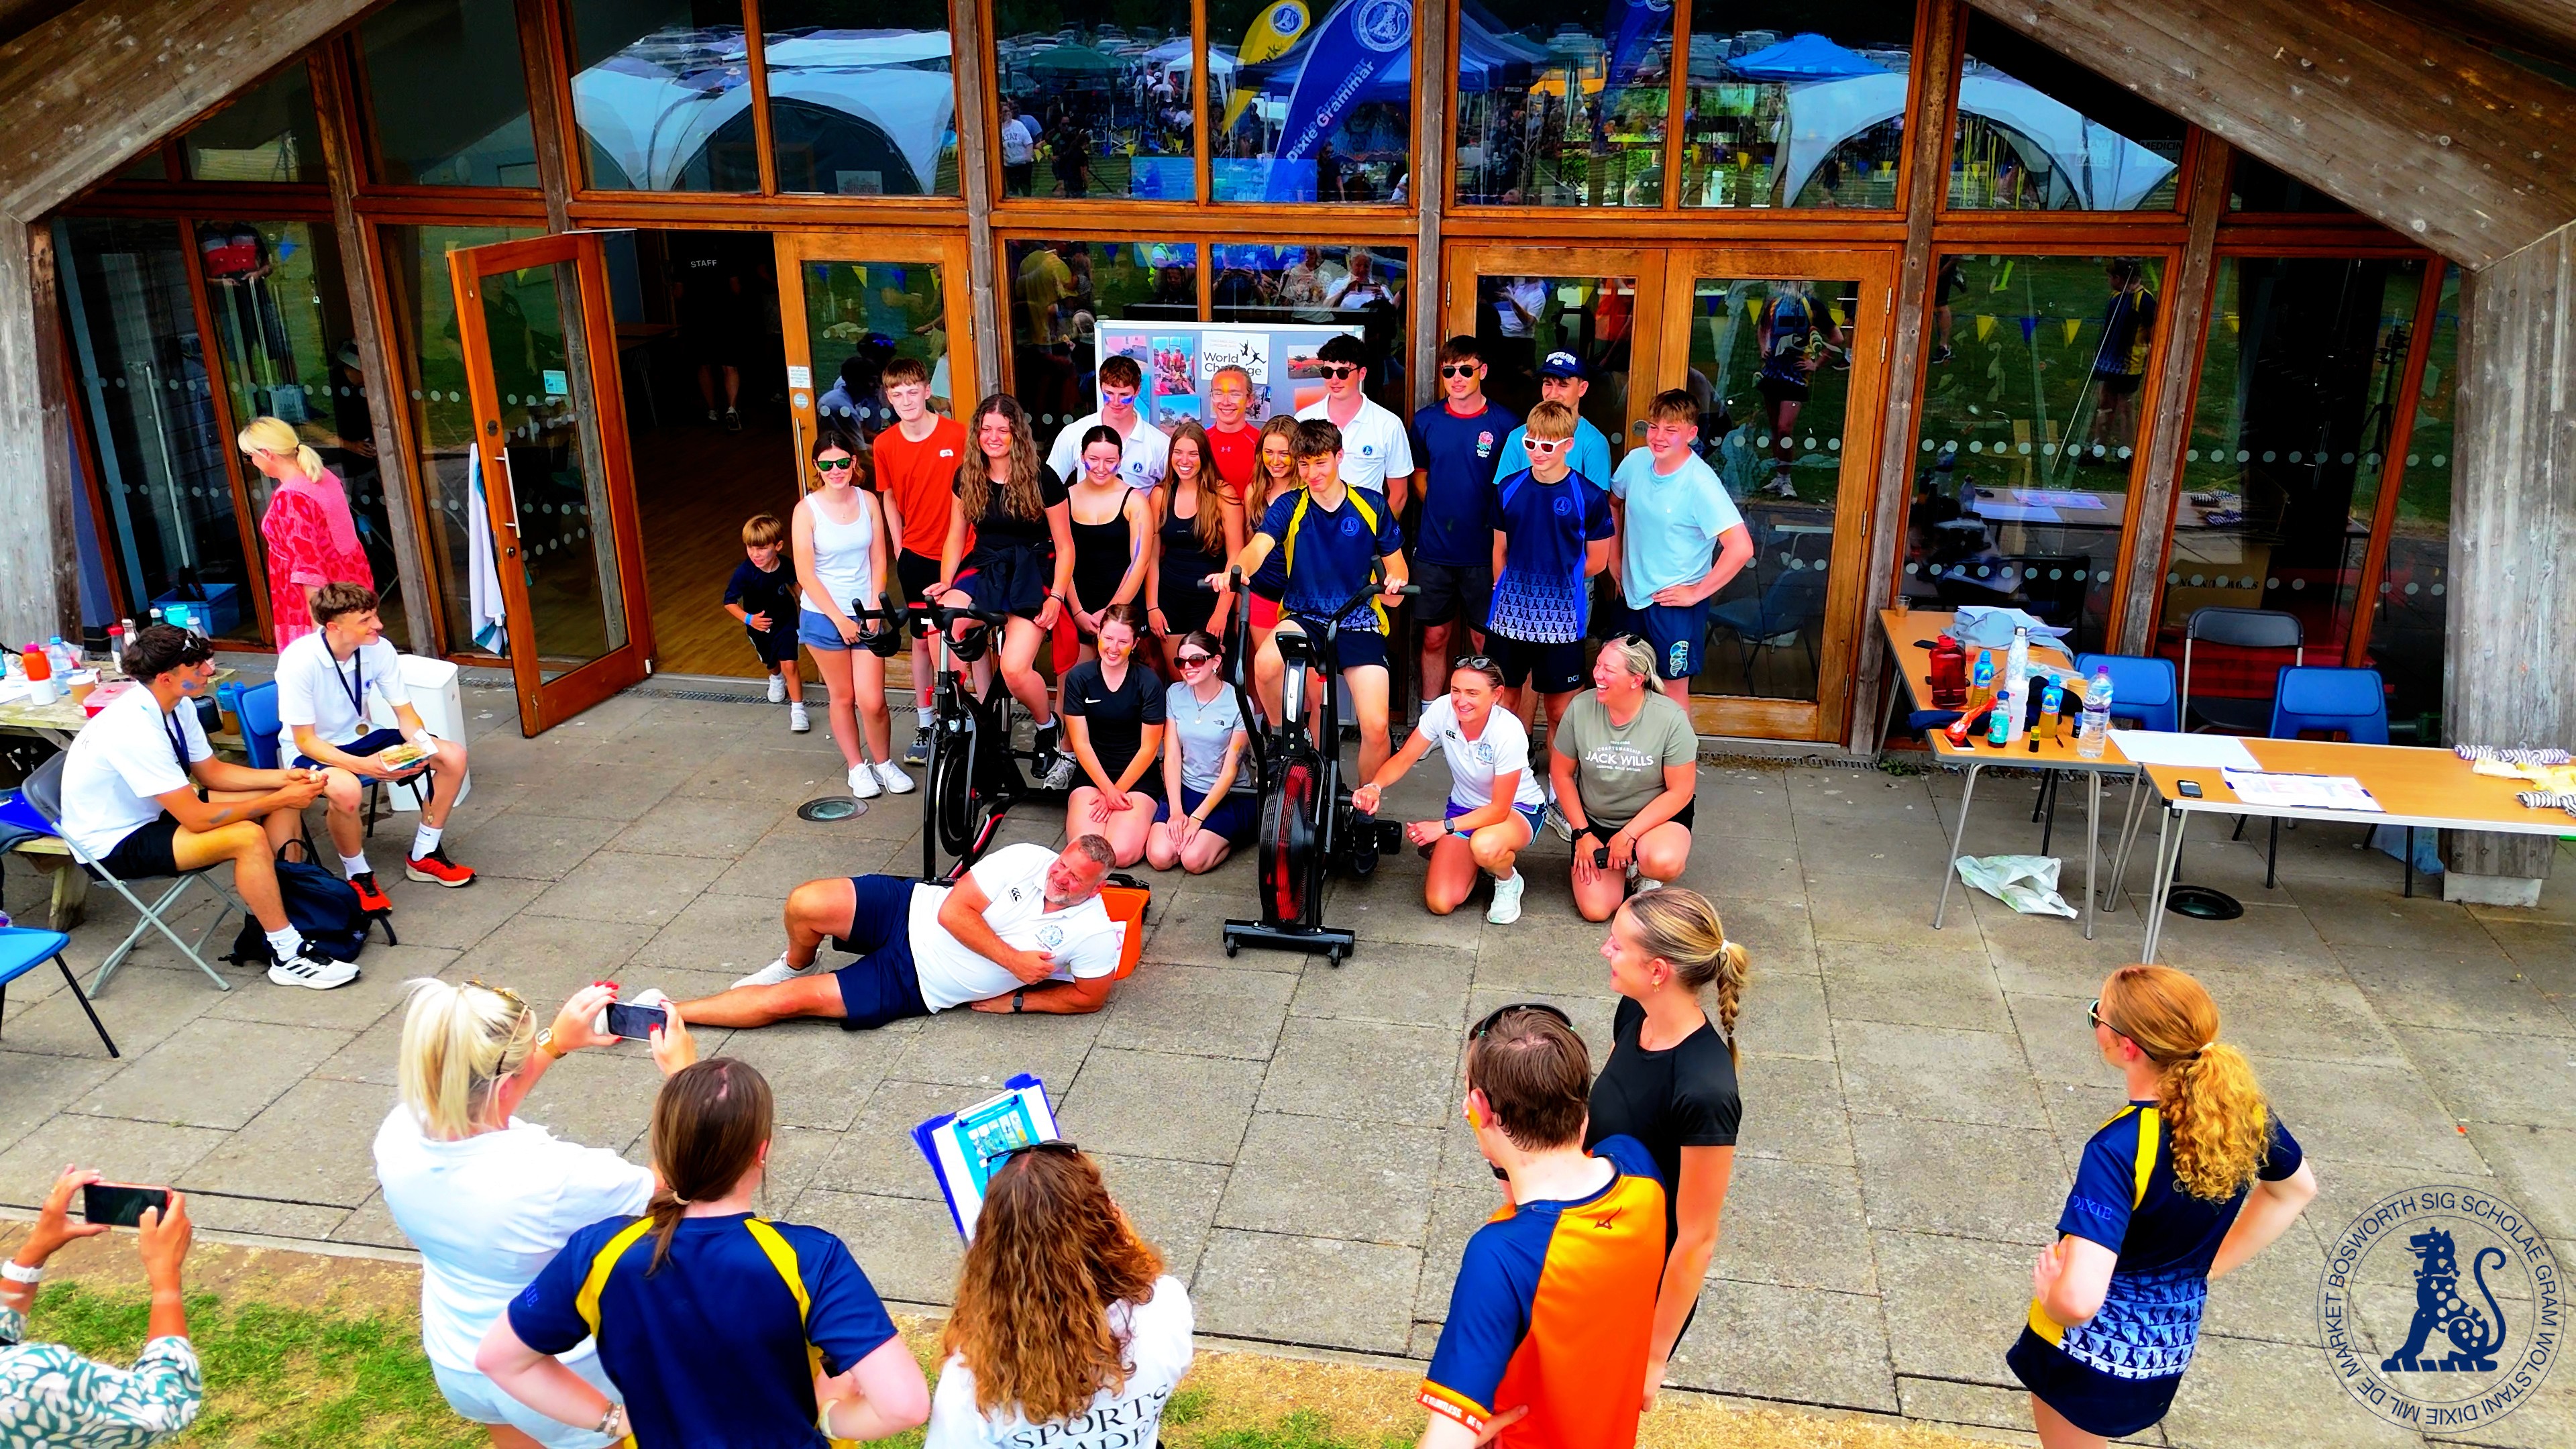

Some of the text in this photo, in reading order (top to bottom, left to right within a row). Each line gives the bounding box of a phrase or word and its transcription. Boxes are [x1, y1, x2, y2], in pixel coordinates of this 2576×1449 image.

[1285, 60, 1375, 164] Dixie Grammar
[690, 260, 717, 268] STAFF
[1203, 352, 1239, 364] World
[1585, 751, 1654, 767] JACK WILLS
[1012, 1383, 1168, 1449] SPORTS
